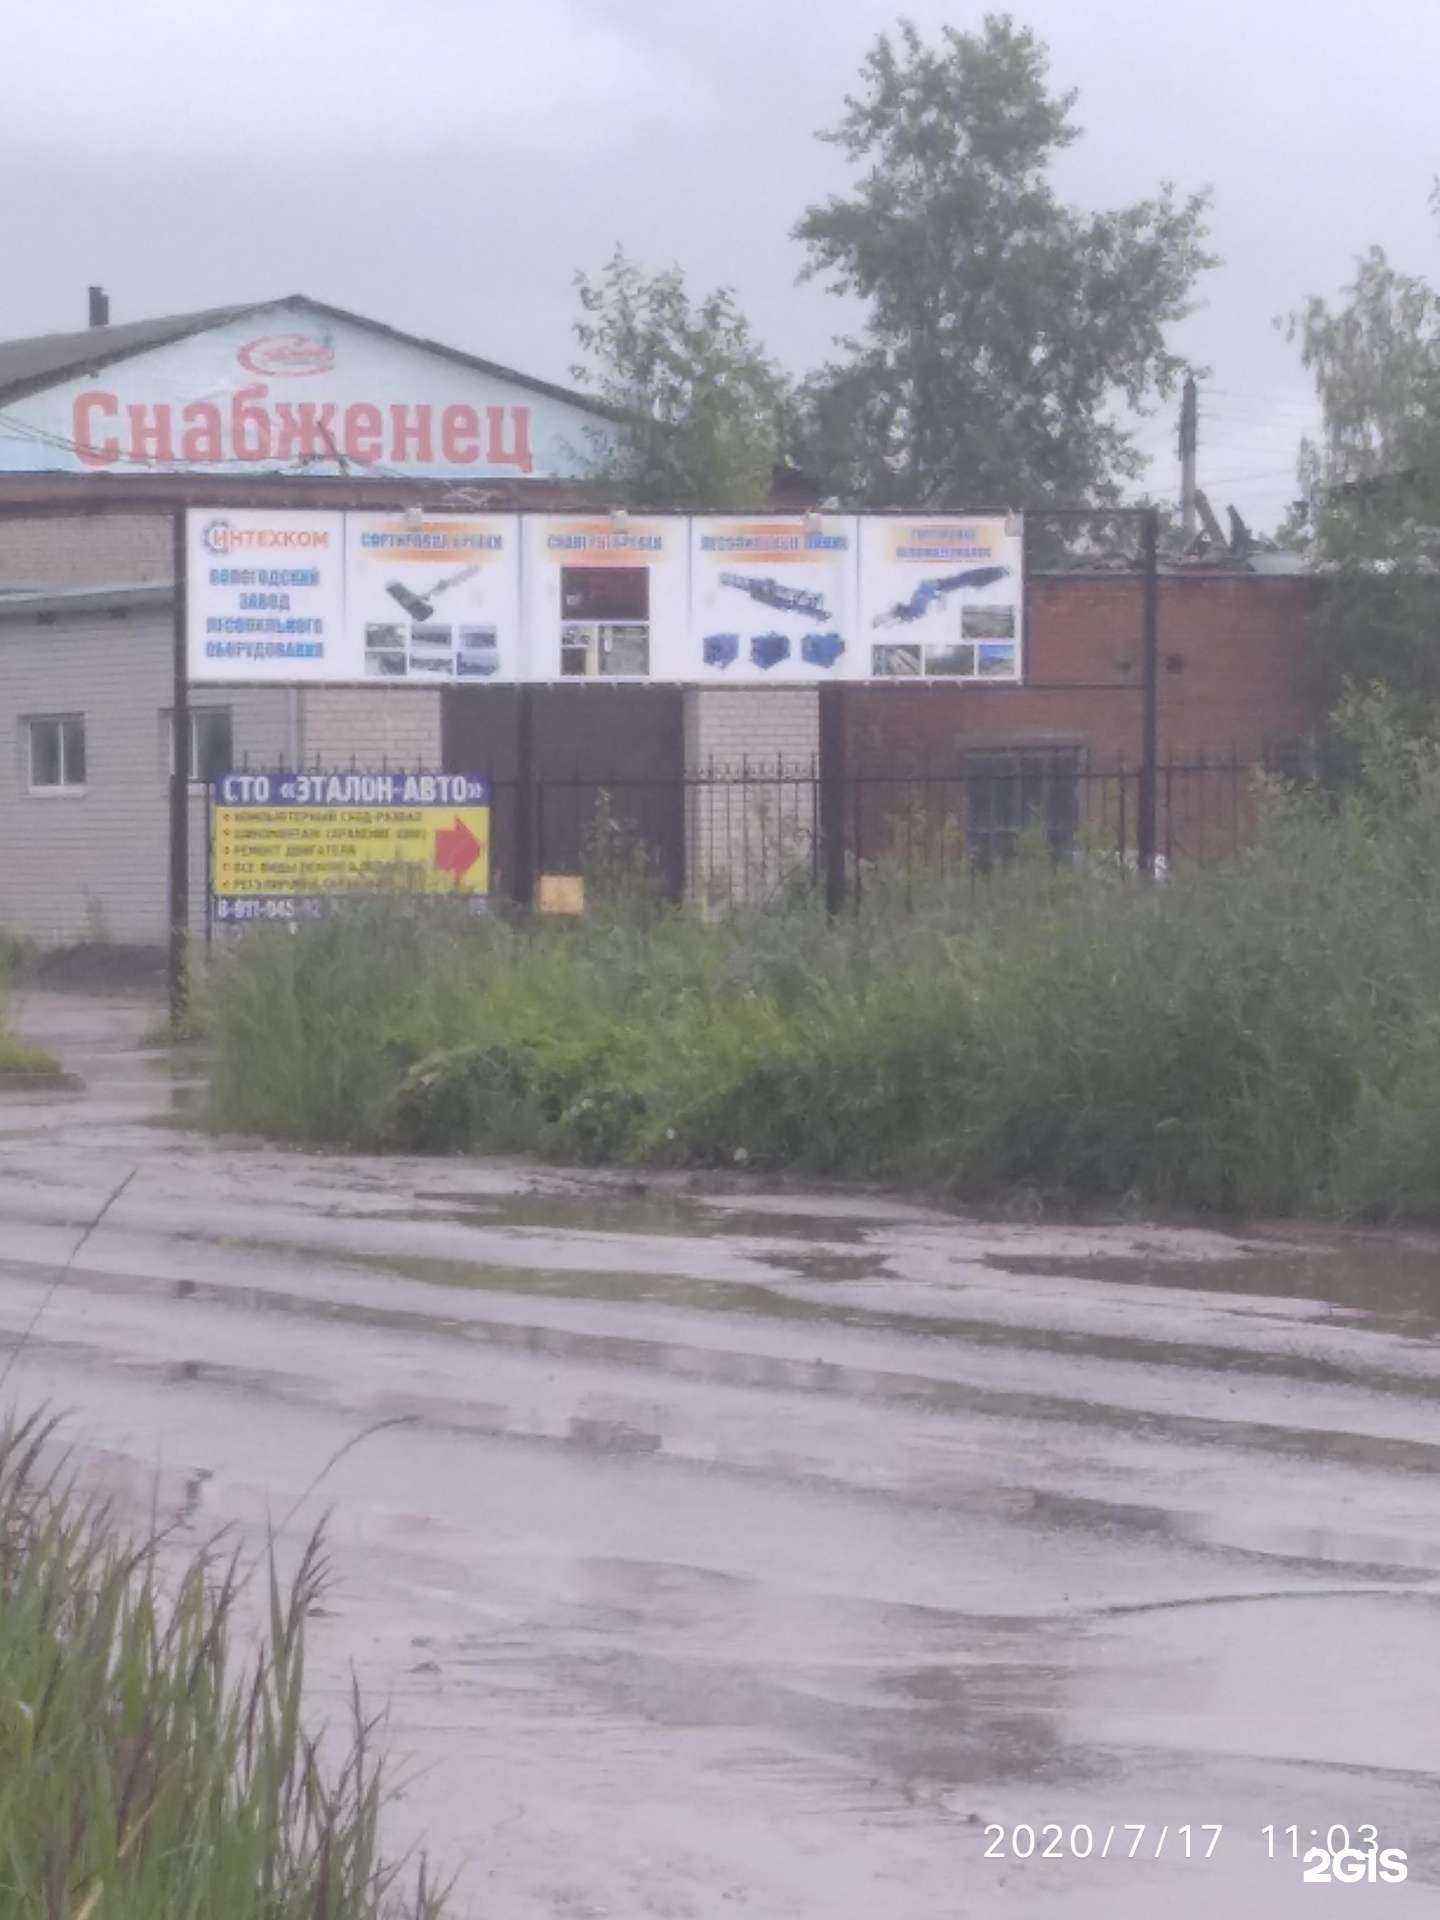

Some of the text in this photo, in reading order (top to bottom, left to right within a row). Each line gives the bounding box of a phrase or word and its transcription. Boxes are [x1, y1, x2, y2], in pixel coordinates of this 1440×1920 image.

[73, 383, 532, 473] Снабженец
[239, 592, 291, 611] ЗАВОД
[223, 776, 269, 802] СТО
